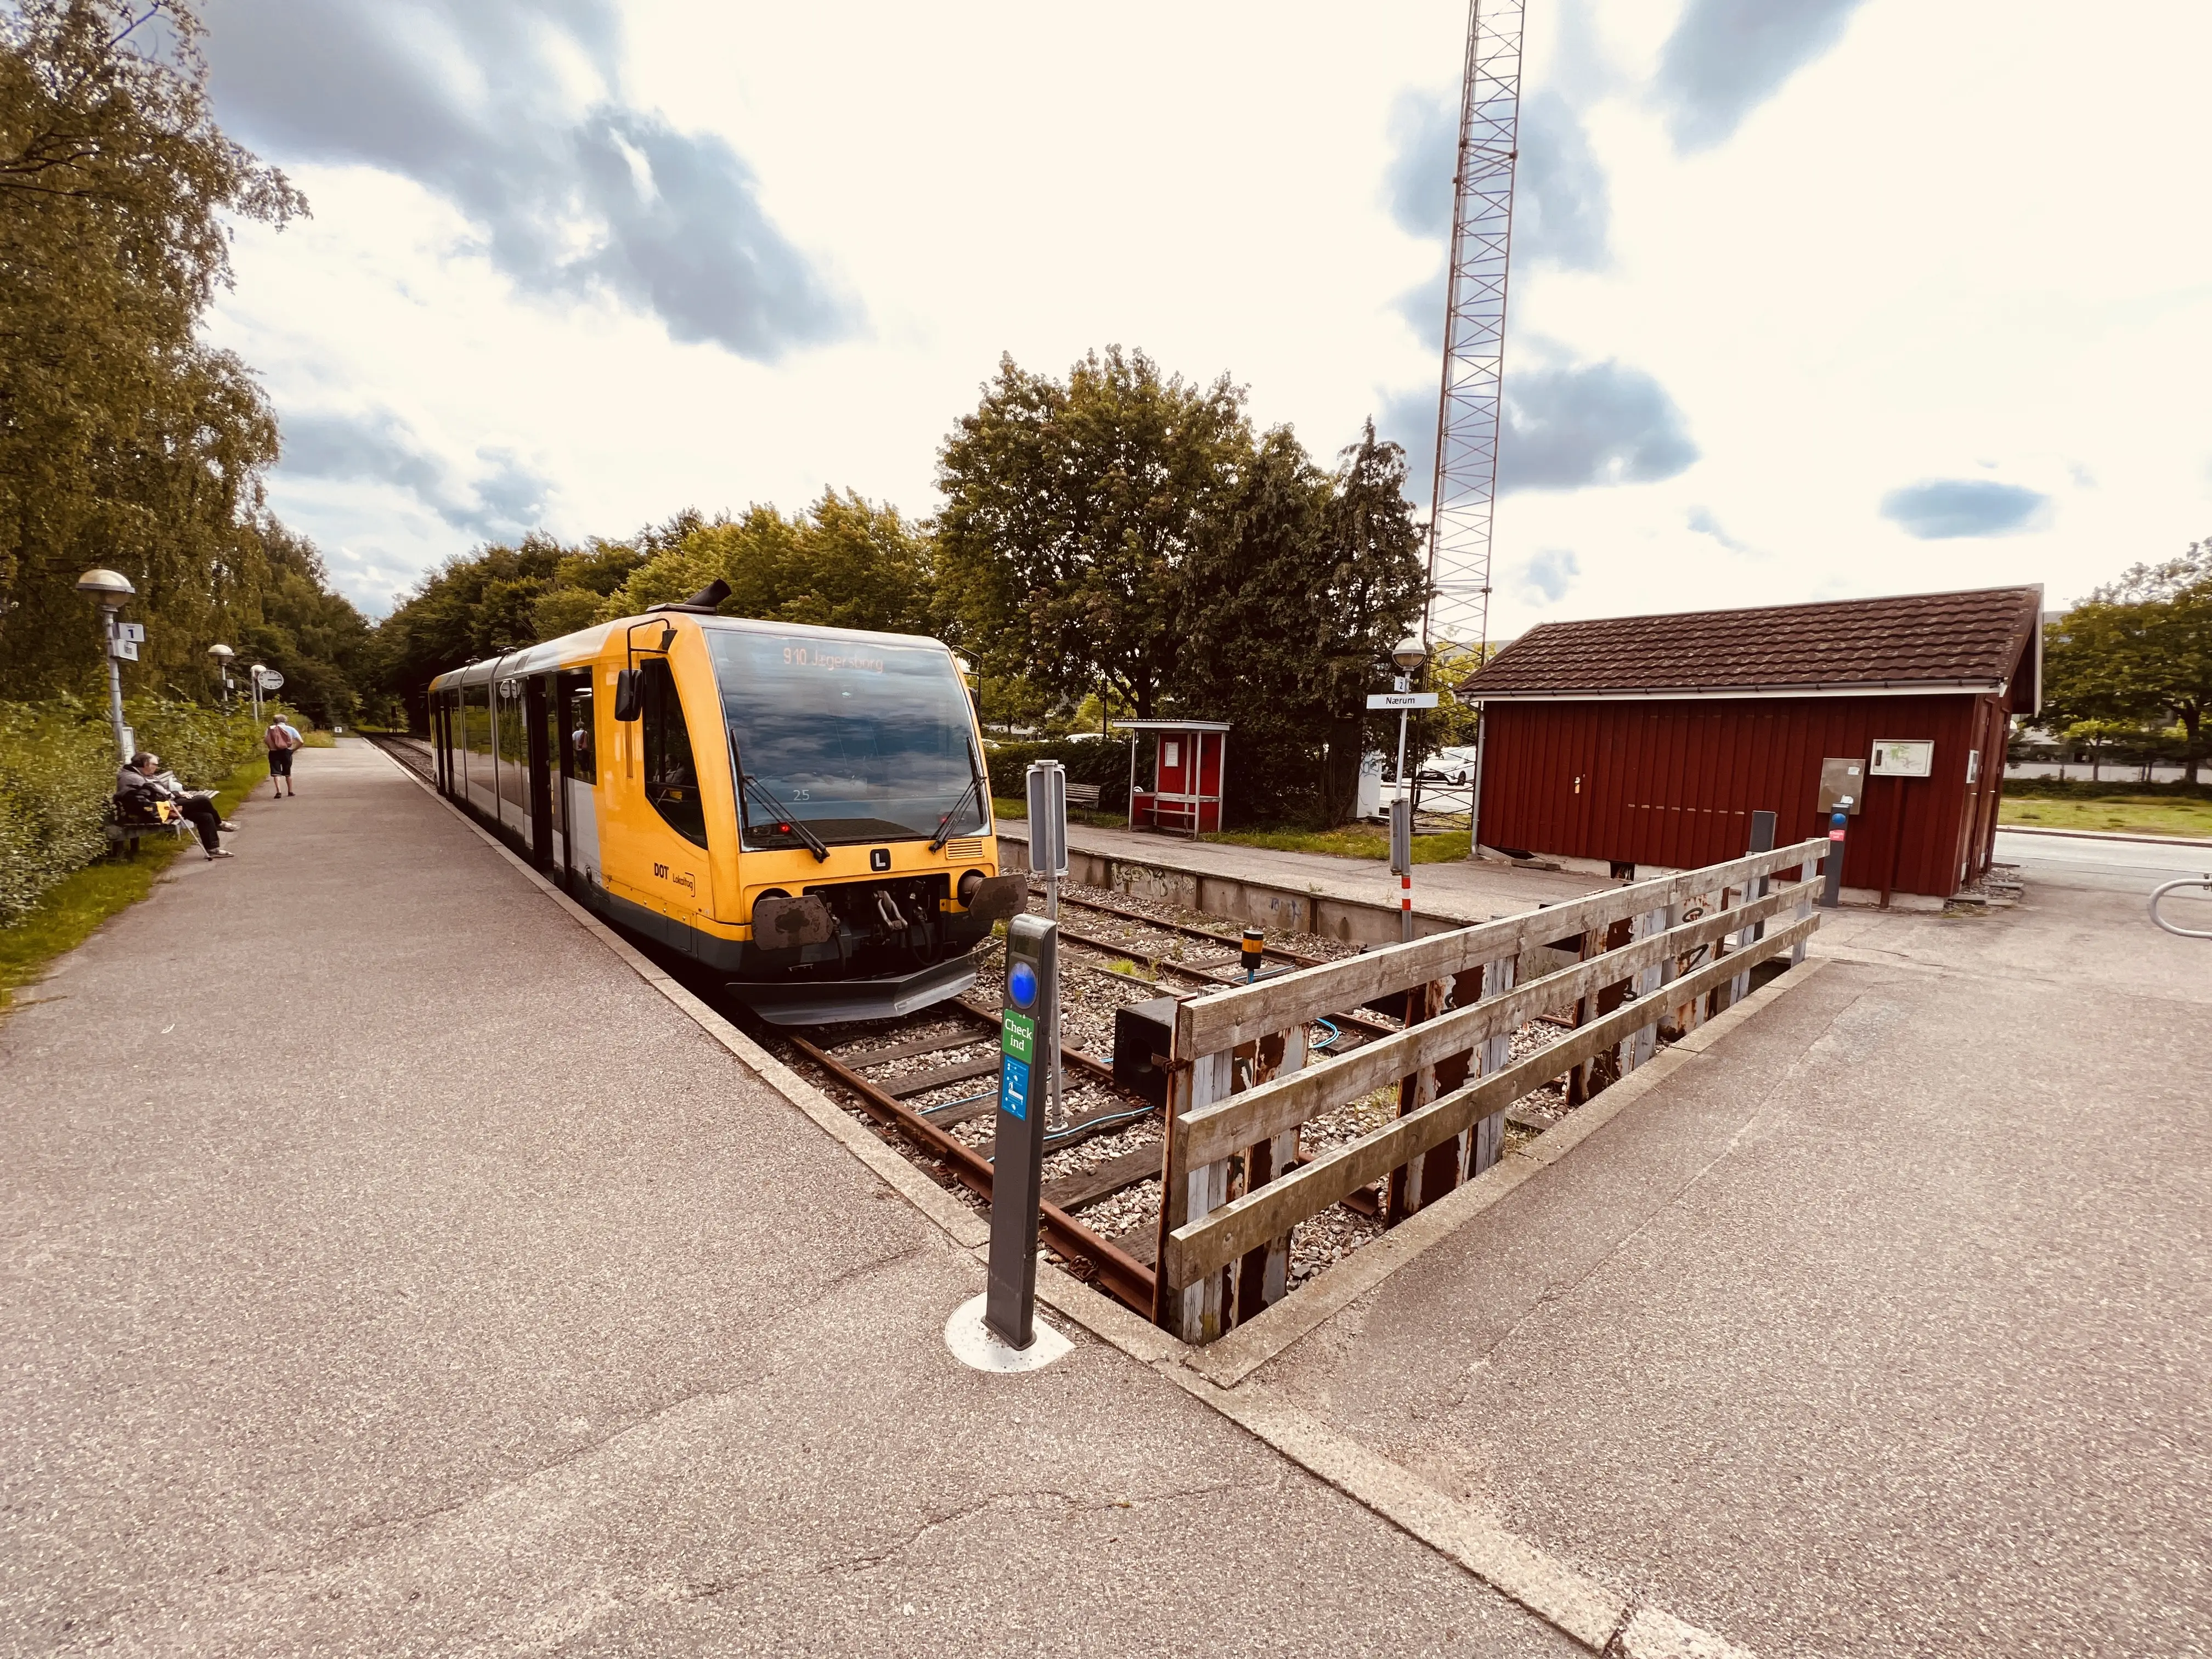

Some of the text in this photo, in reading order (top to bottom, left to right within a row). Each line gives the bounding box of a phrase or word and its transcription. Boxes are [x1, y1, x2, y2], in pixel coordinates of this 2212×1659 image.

[128, 629, 134, 639] 1
[783, 647, 807, 665] 910
[1399, 681, 1403, 690] 2
[793, 789, 810, 801] 25
[875, 853, 886, 867] L
[654, 862, 669, 880] DOT
[1005, 1018, 1032, 1040] Check
[1010, 1034, 1025, 1051] ind
